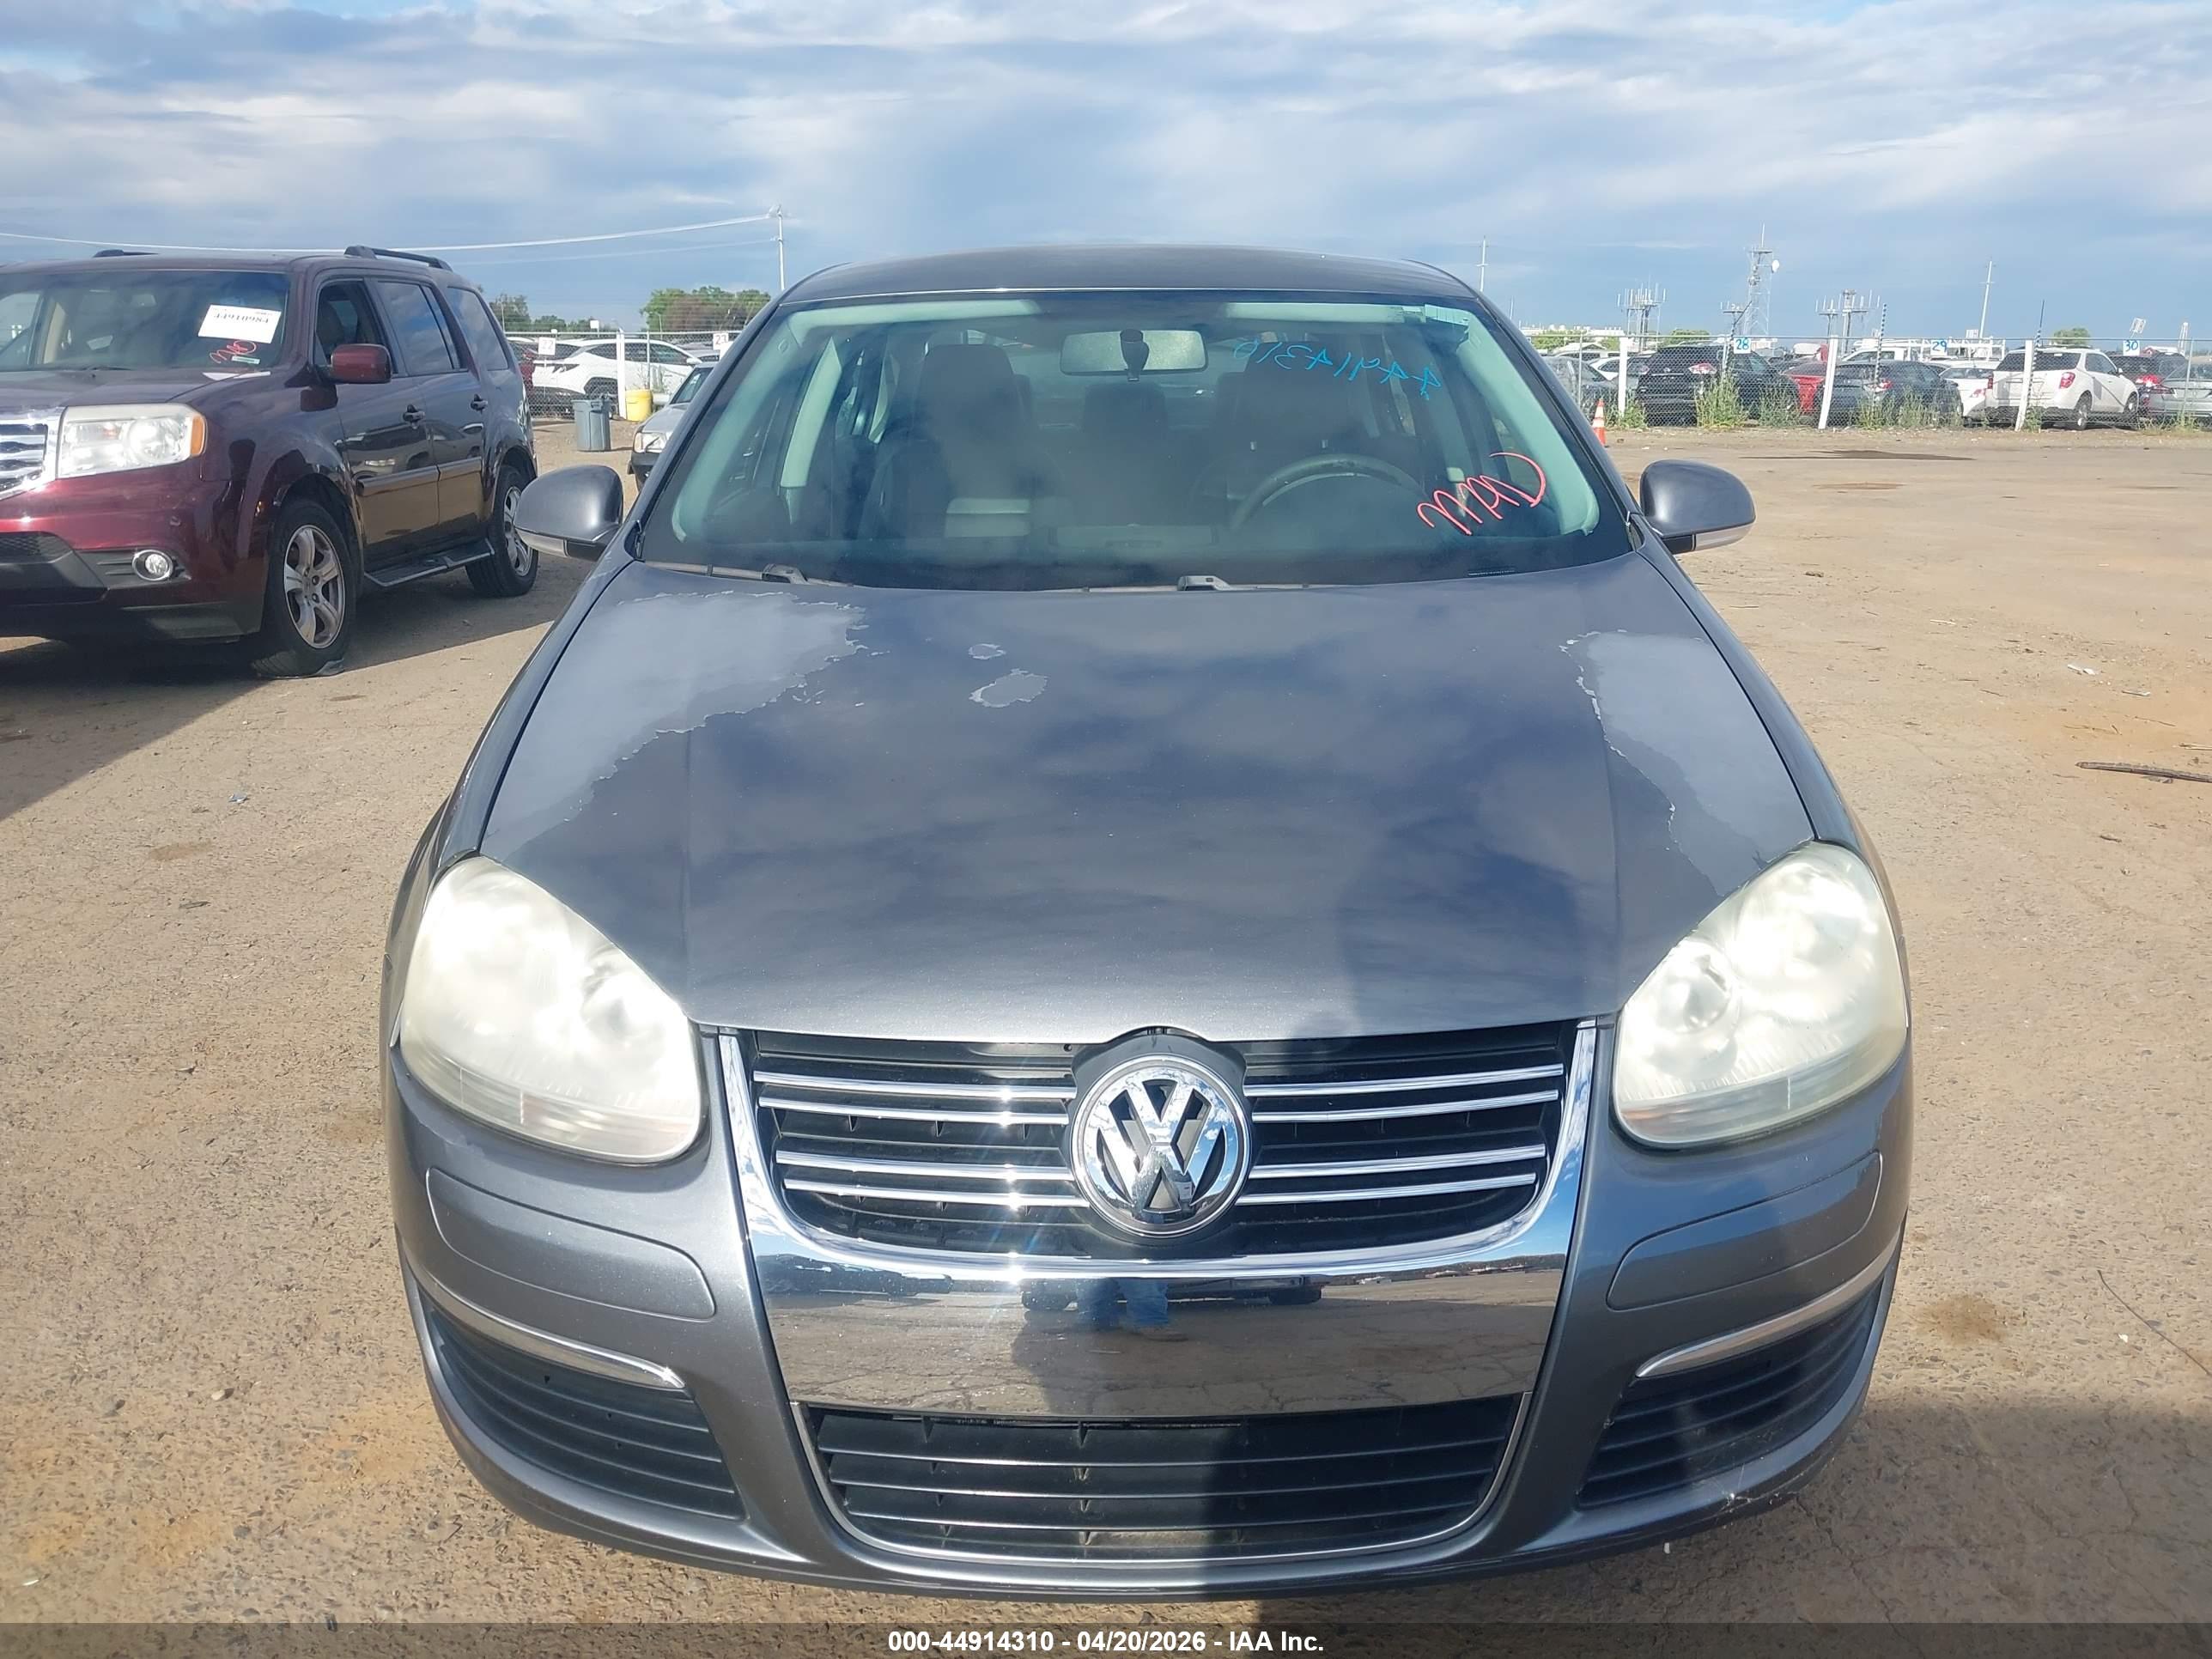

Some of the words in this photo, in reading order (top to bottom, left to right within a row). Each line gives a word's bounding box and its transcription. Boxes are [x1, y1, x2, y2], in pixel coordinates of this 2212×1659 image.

[1735, 337, 1749, 350] 28
[1932, 340, 1947, 353] 29
[2125, 339, 2138, 351] 30
[1082, 1066, 1240, 1218] VW
